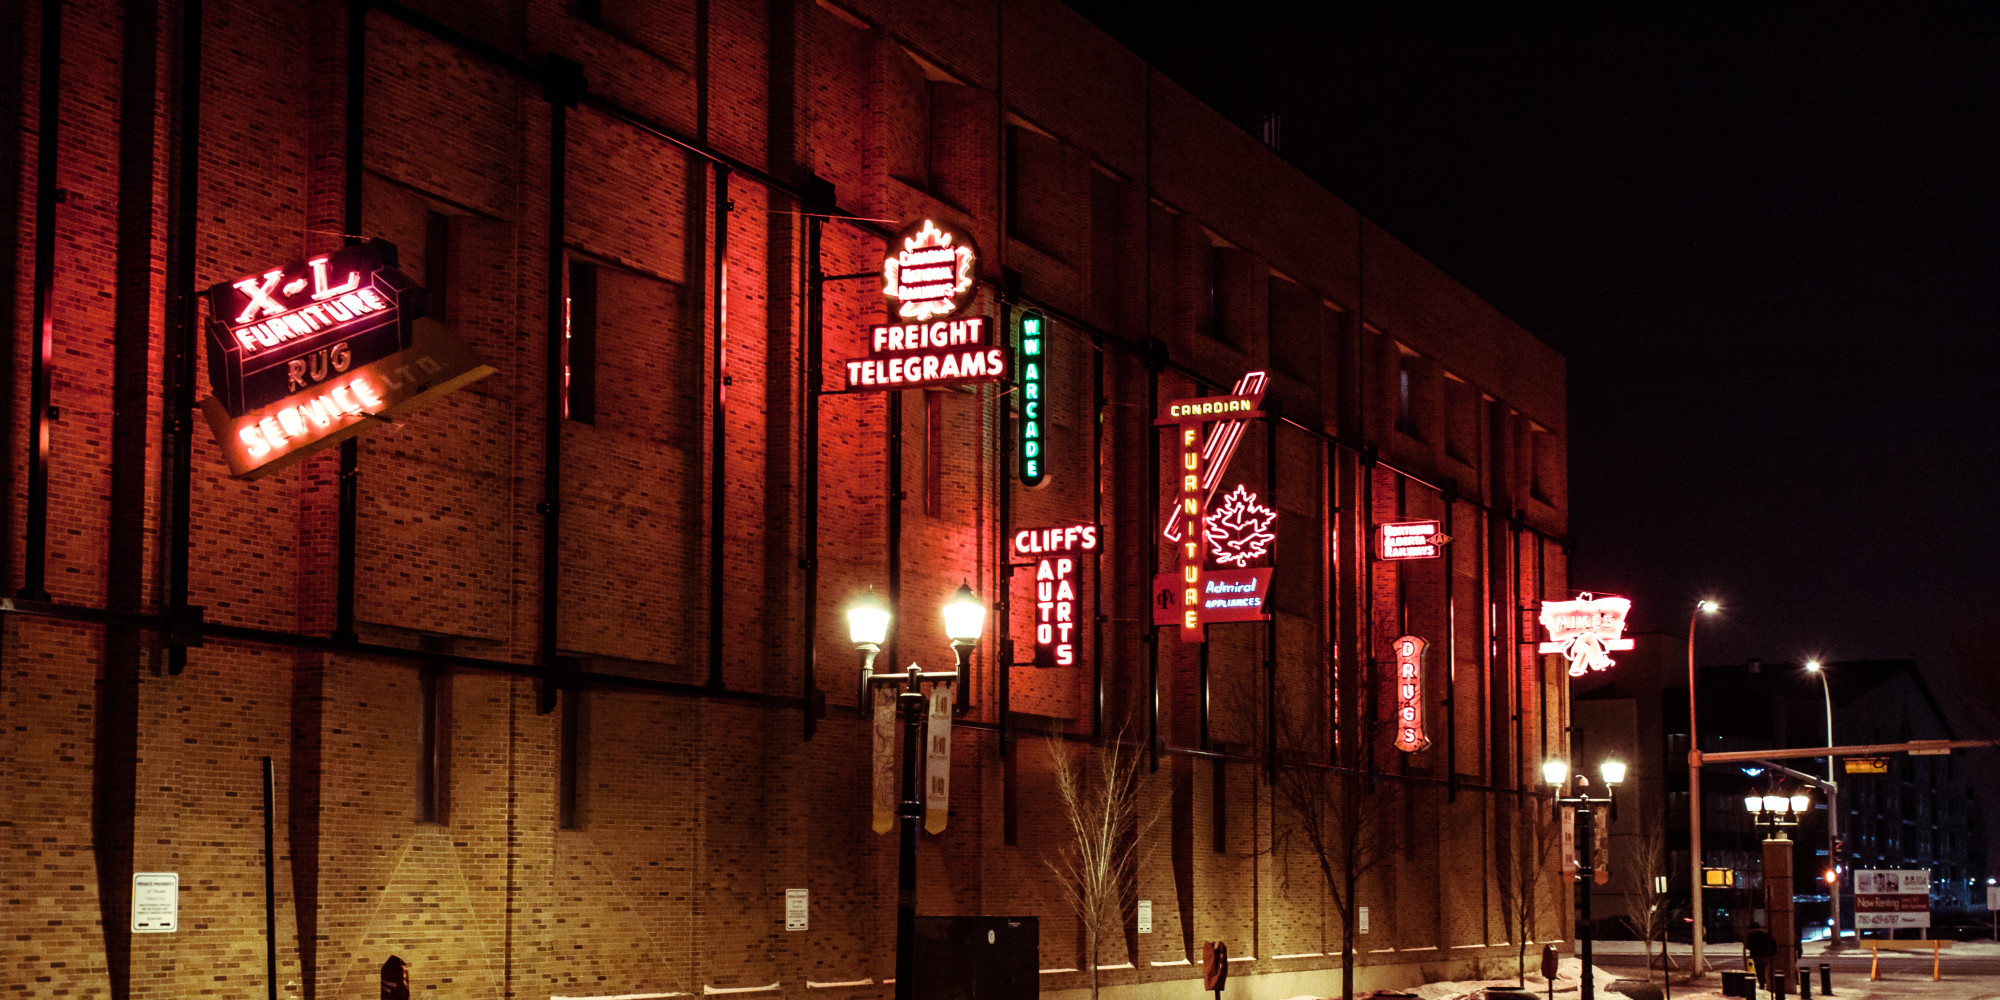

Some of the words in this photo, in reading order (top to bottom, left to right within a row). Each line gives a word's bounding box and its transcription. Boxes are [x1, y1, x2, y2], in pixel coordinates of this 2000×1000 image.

[233, 257, 361, 324] X-L
[235, 288, 387, 352] FURNITURE
[873, 318, 982, 352] FREIGHT
[287, 342, 351, 392] RUG
[846, 349, 1004, 386] TELEGRAMS
[238, 377, 383, 457] SERVICE
[1025, 363, 1039, 478] ARCADE
[1170, 399, 1251, 418] CANADIAN
[1015, 525, 1097, 553] CLIFF'S
[1184, 429, 1198, 629] FURNITURE
[1036, 559, 1055, 645] AUTO
[1056, 558, 1075, 666] PARTS
[1204, 597, 1262, 609] APPLIANCES
[1205, 577, 1257, 593] Admiral
[1401, 640, 1417, 743] DRUGS
[1857, 897, 1874, 908] Now
[1875, 897, 1899, 911] Renting
